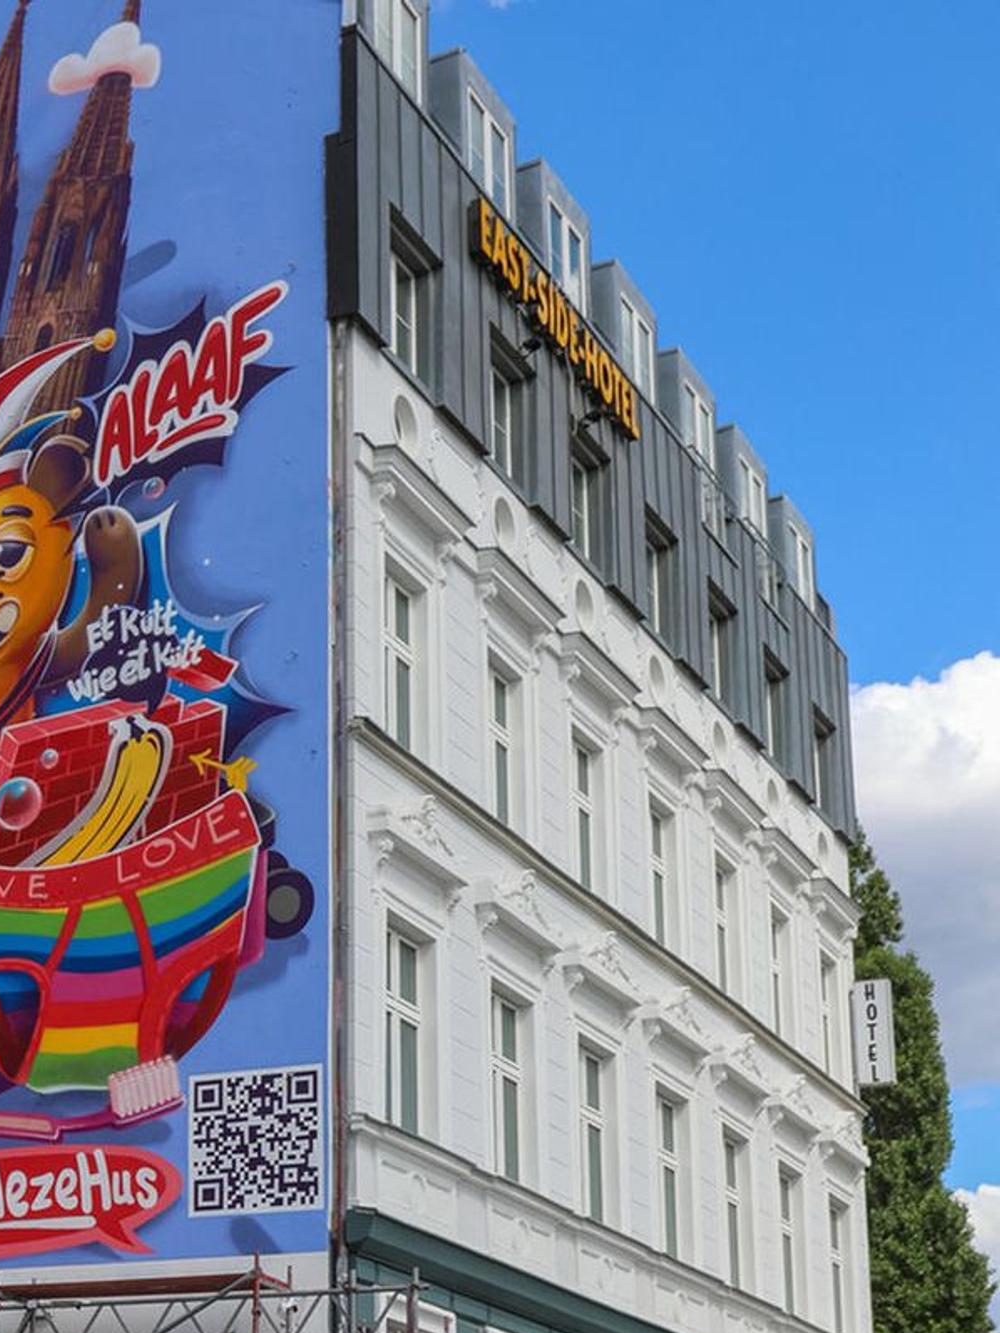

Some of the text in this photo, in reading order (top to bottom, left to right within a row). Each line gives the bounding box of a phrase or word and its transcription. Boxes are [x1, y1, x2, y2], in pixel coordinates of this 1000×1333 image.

[97, 281, 287, 486] ALAAF
[117, 803, 240, 884] LOVE
[864, 983, 880, 1082] HOTEL
